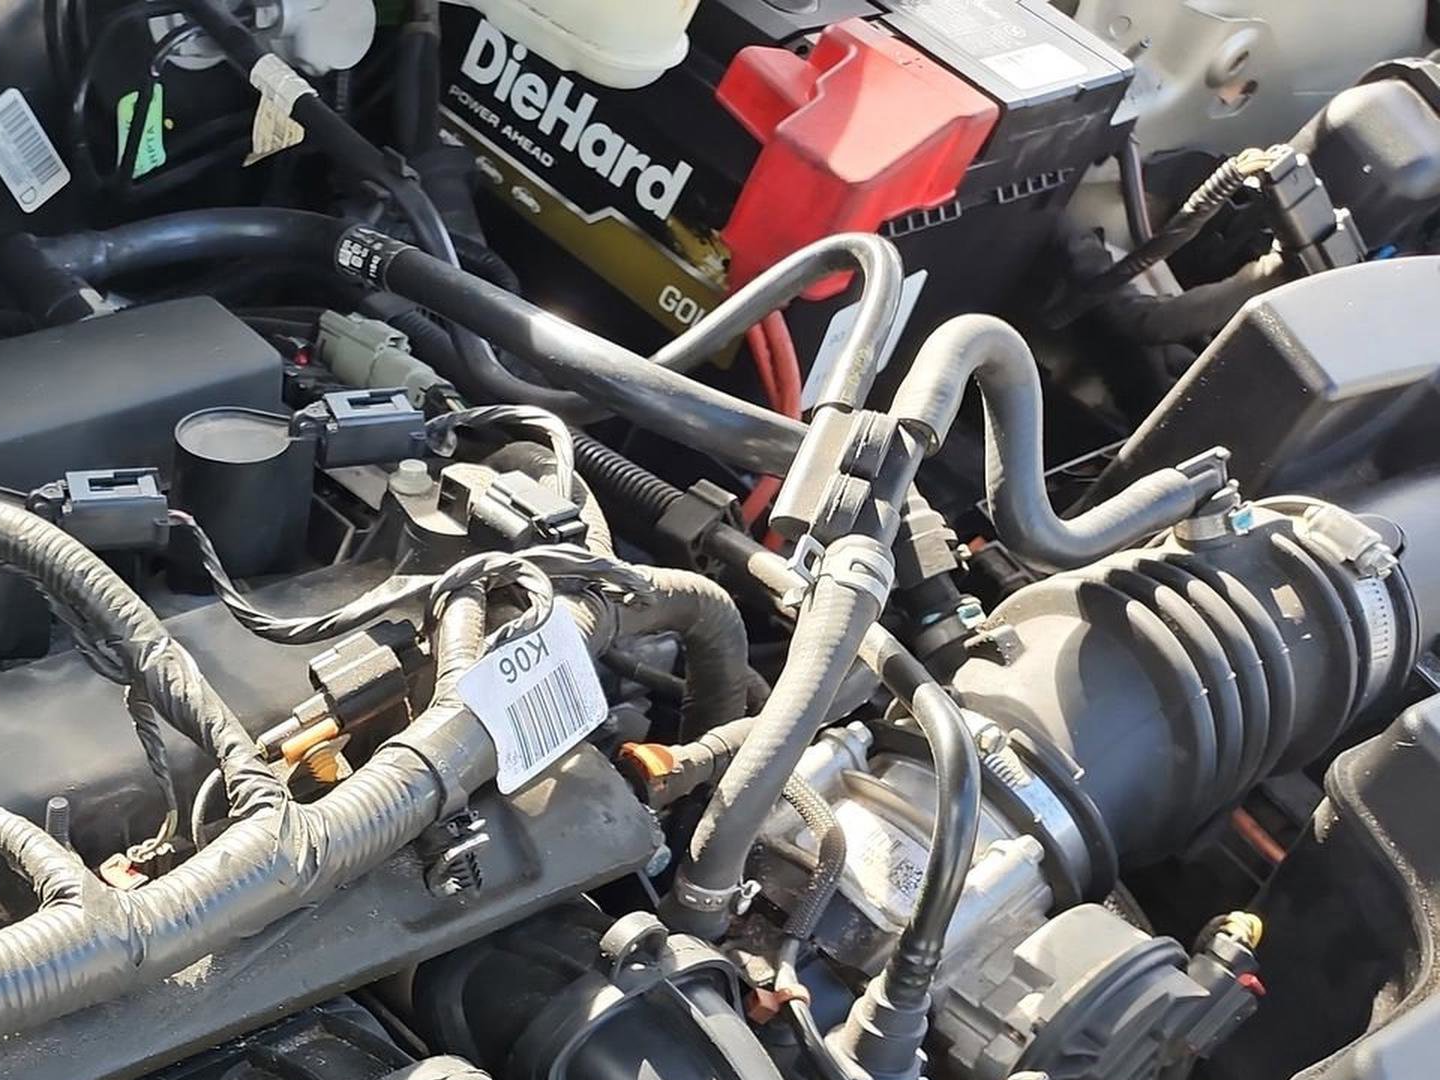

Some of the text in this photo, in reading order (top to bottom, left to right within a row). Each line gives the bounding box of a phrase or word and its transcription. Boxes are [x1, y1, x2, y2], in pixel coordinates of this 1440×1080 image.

[448, 84, 555, 168] POWER AHEAD
[460, 18, 694, 220] DieHard
[659, 285, 706, 328] GOL
[499, 632, 550, 684] K06
